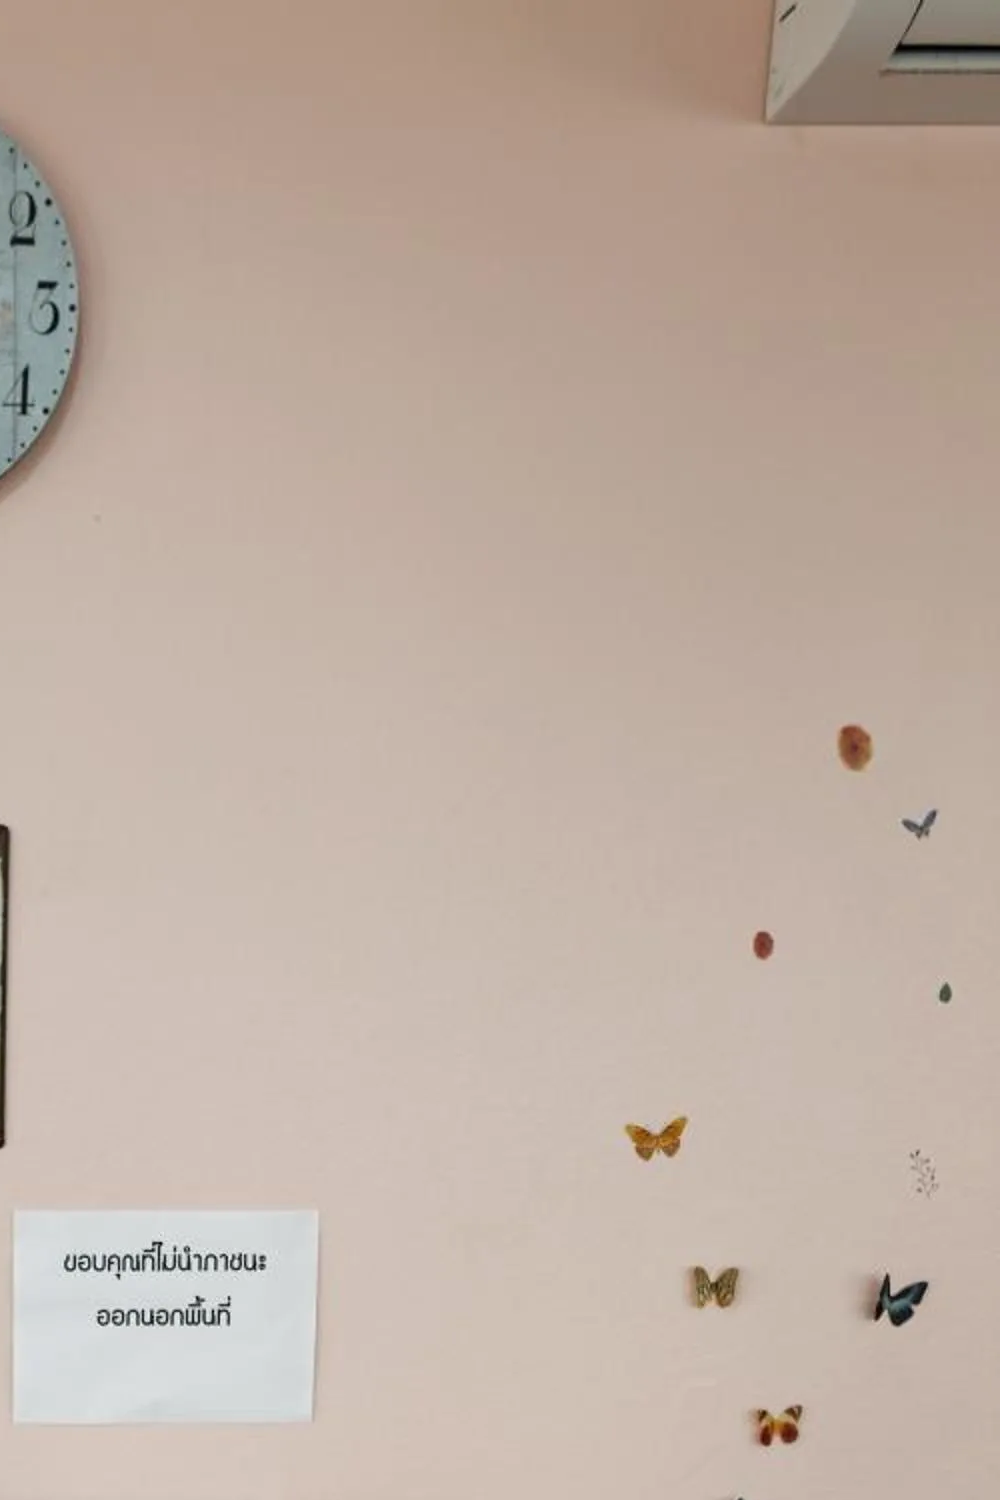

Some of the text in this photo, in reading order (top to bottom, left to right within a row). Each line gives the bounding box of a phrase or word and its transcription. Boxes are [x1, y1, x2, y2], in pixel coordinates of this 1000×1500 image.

[9, 191, 36, 247] 2
[28, 281, 60, 335] 3
[2, 364, 35, 416] 4
[96, 1295, 232, 1327] ออกนอกพื้นที่
